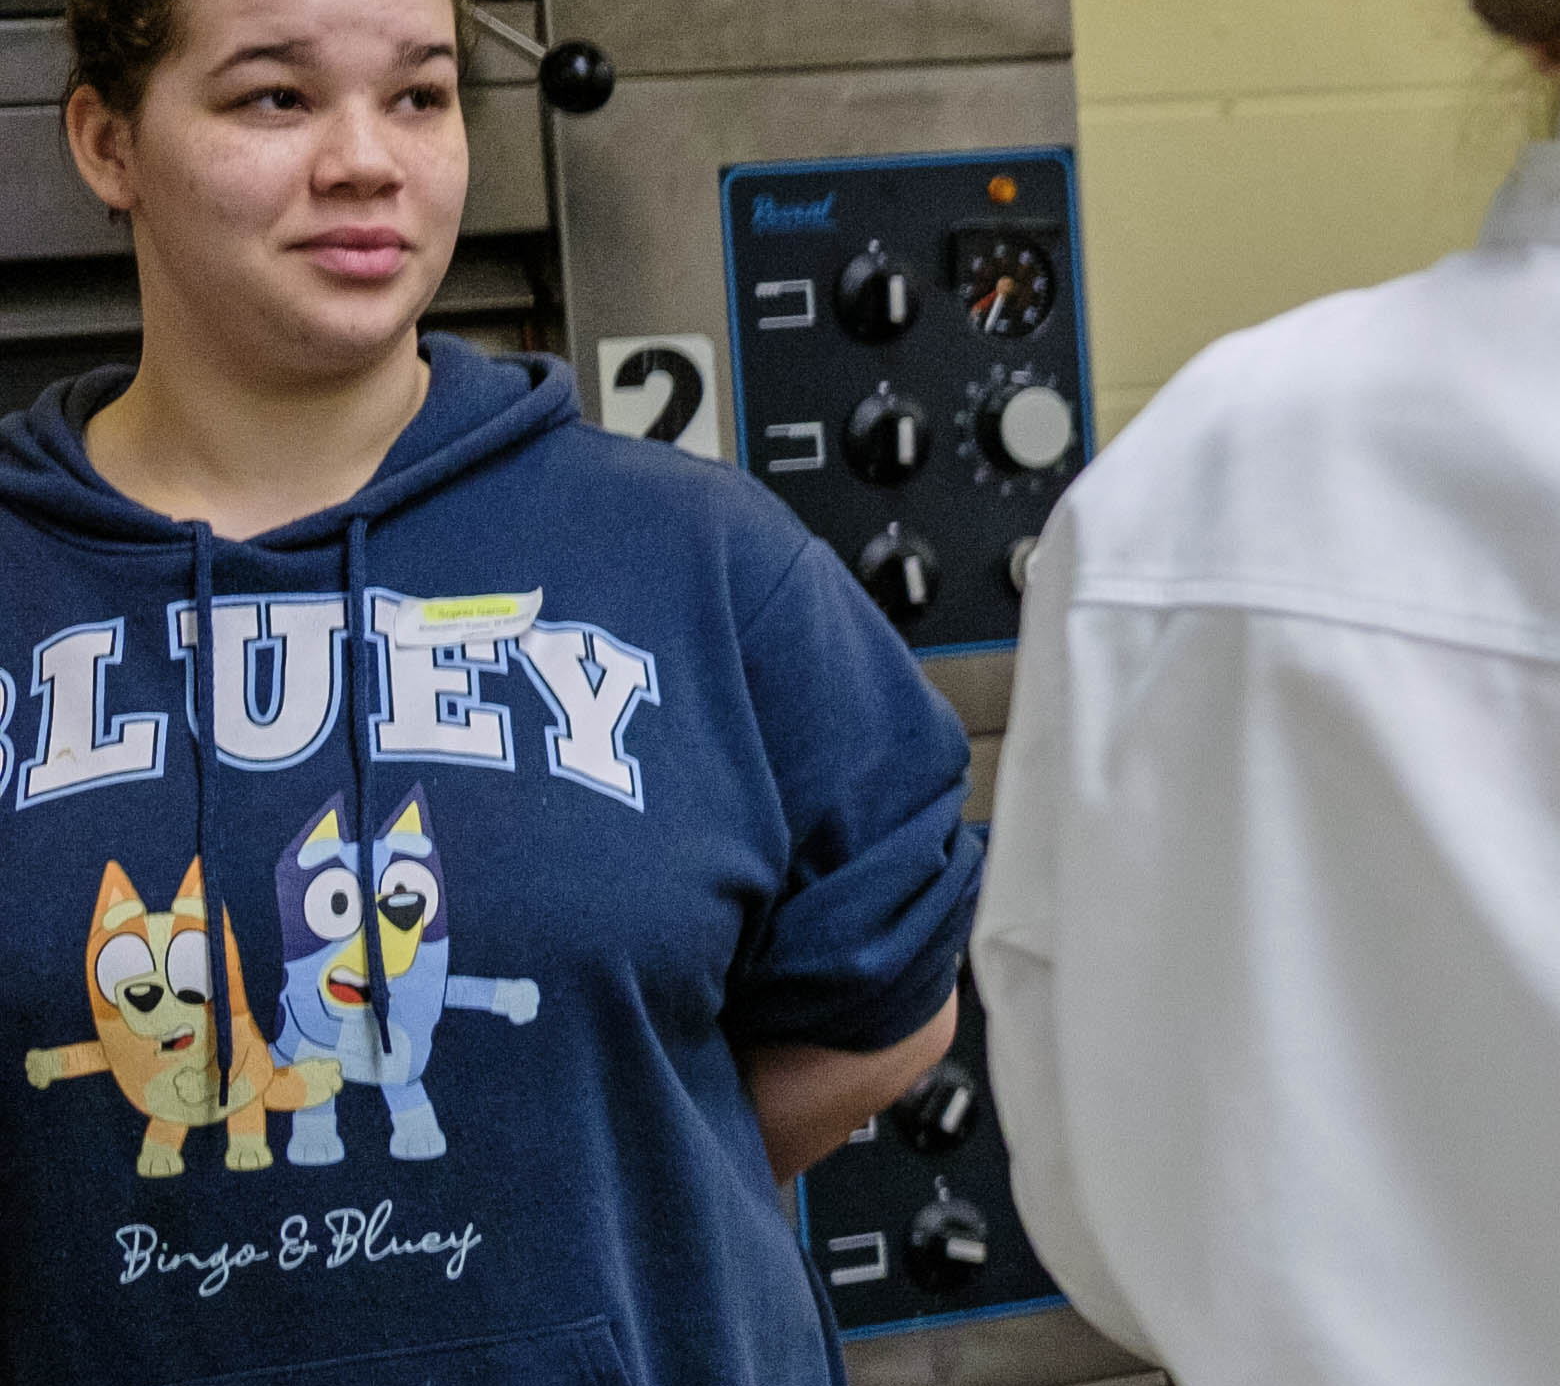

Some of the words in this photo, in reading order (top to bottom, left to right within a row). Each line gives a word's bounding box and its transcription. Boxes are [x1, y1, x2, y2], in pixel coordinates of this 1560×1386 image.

[613, 346, 703, 445] 2
[0, 587, 661, 812] LUEY
[115, 1224, 268, 1296] Bingo
[279, 1215, 317, 1270] &
[325, 1199, 482, 1280] Bluey
